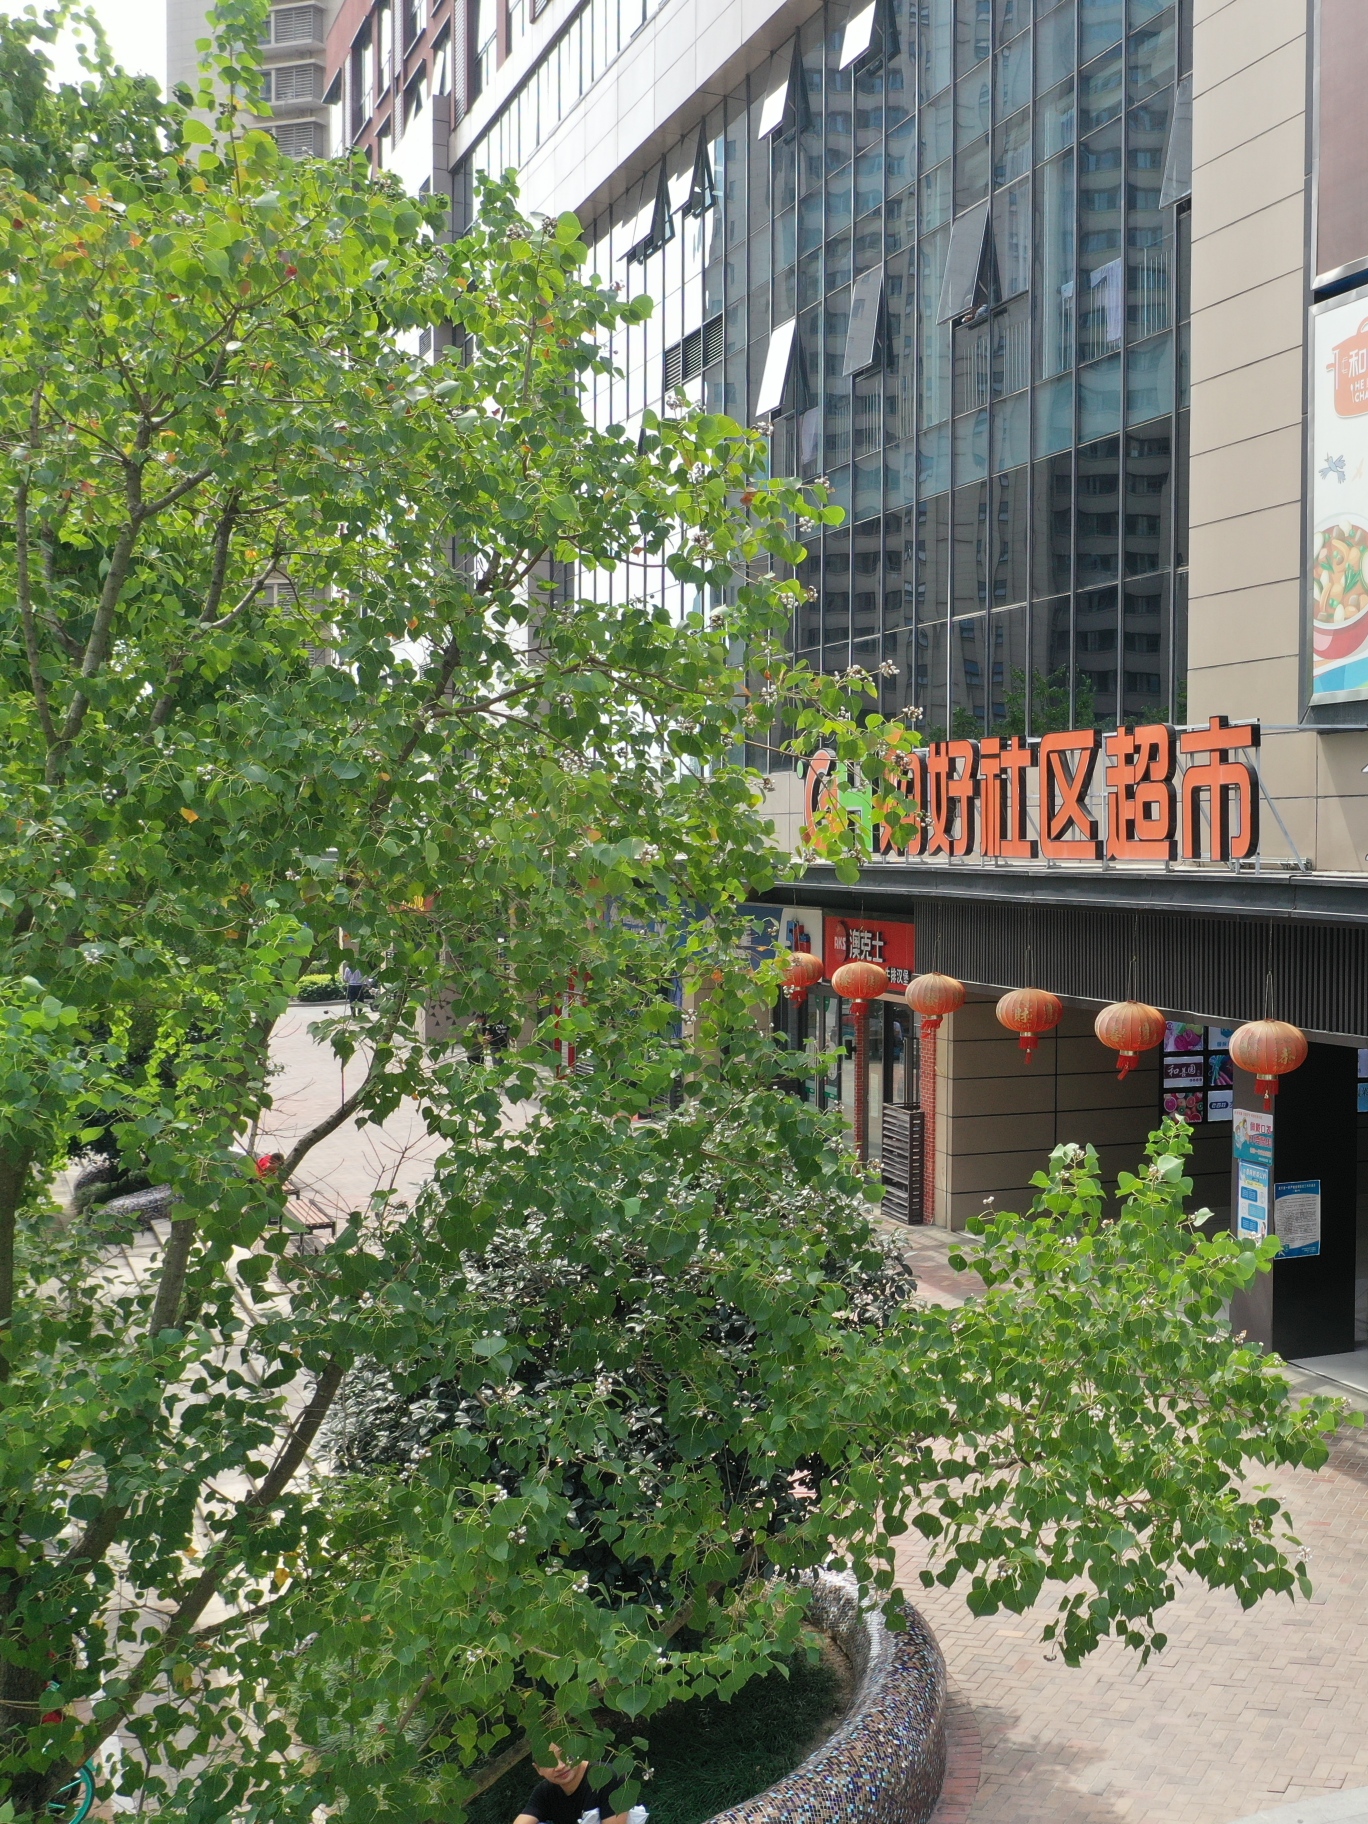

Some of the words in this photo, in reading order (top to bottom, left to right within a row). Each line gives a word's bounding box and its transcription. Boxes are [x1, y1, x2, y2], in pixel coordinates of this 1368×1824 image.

[1355, 380, 1365, 390] HE
[849, 929, 884, 962] 澳克士
